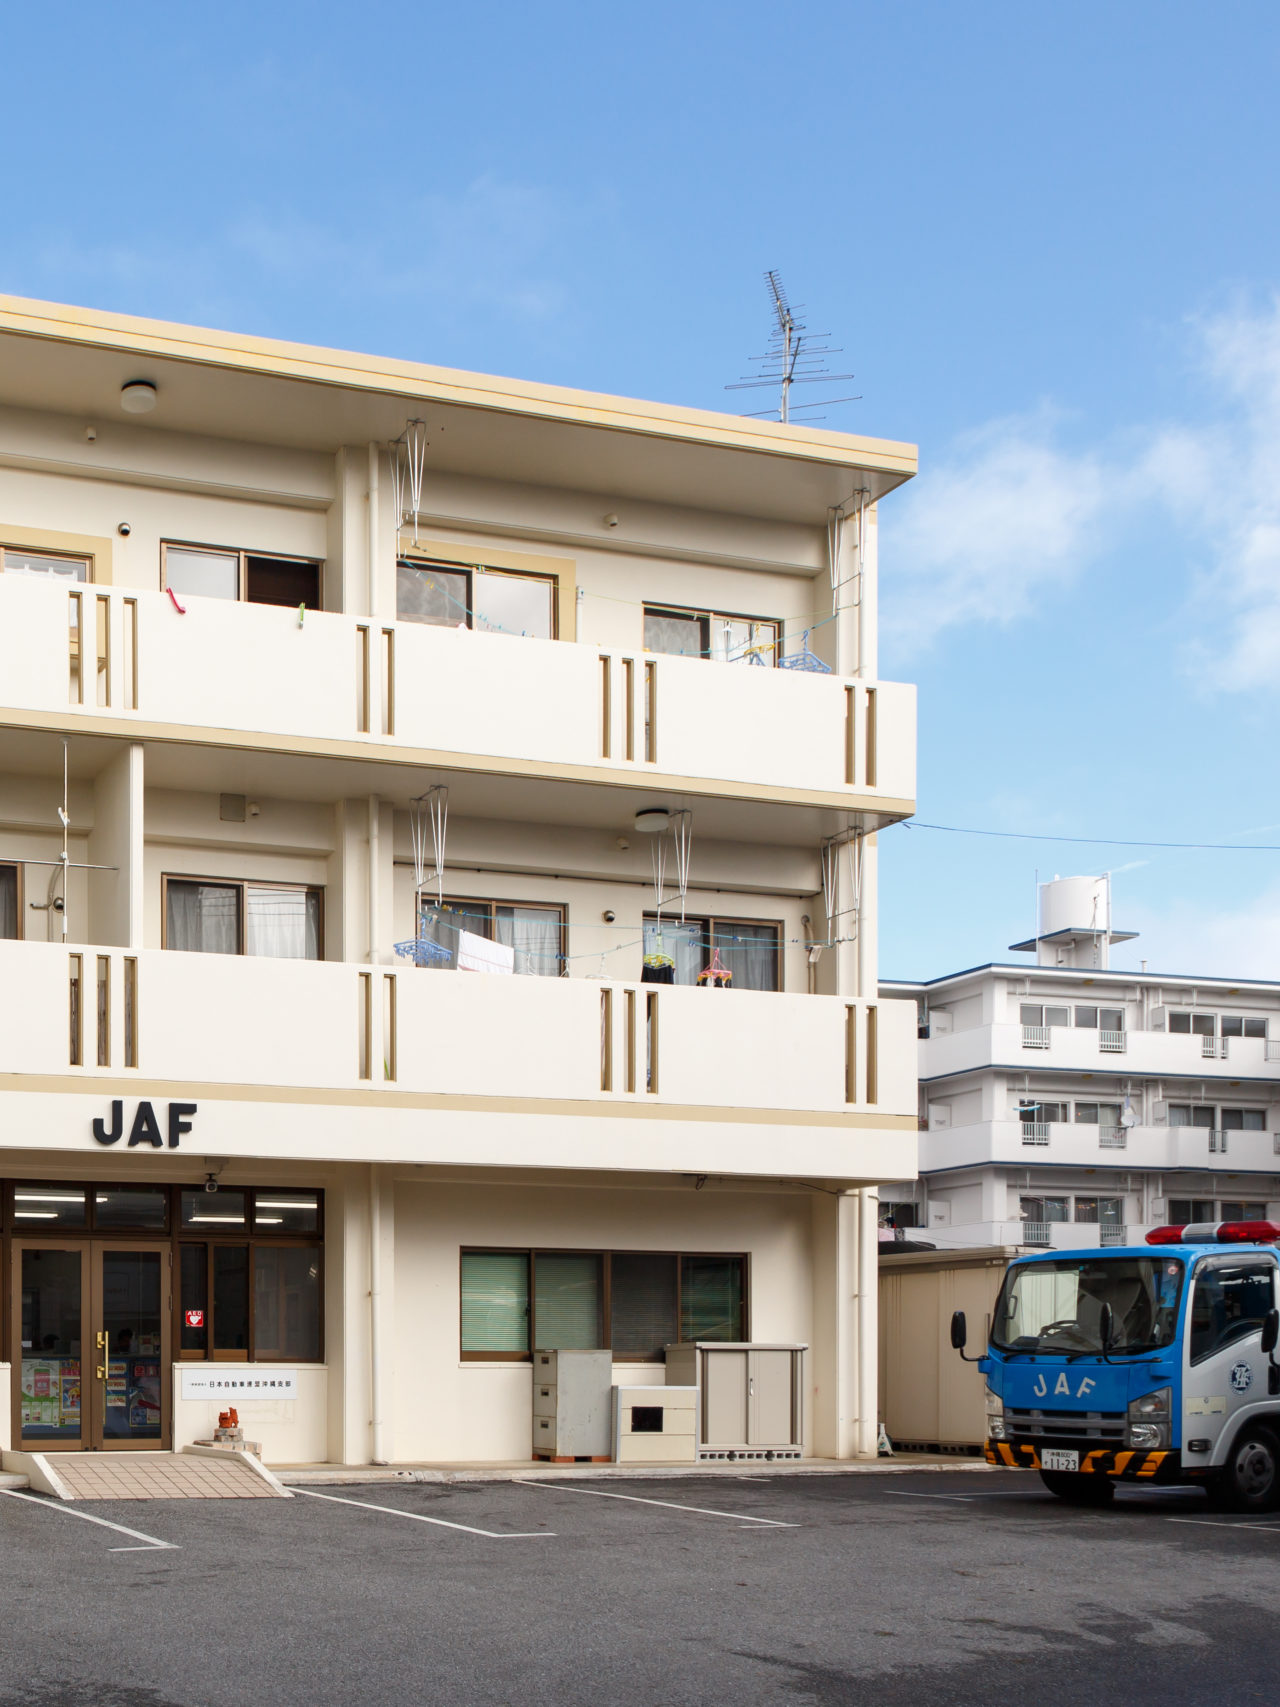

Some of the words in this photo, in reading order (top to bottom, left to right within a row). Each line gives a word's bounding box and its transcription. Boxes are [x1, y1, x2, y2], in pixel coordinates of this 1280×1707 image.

[93, 1100, 197, 1148] JAF
[1033, 1372, 1097, 1398] JAF
[1050, 1458, 1077, 1470] 11-23
